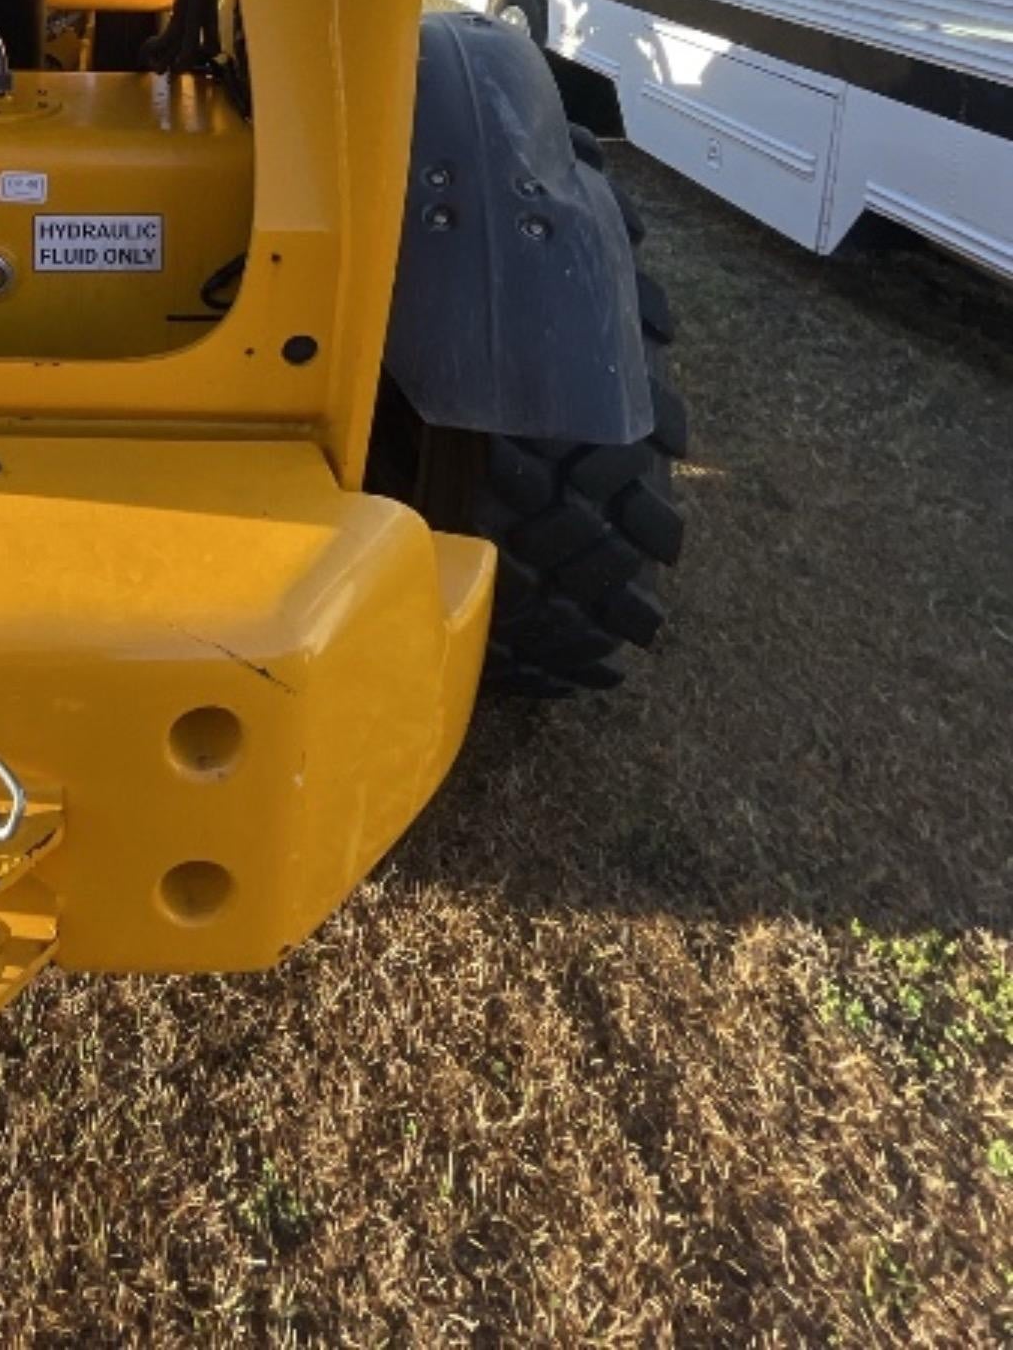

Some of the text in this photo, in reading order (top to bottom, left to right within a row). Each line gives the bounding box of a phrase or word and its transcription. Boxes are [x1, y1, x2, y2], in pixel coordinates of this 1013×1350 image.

[39, 220, 157, 240] HYDRAULIC
[39, 248, 157, 265] FLUID ONLY
